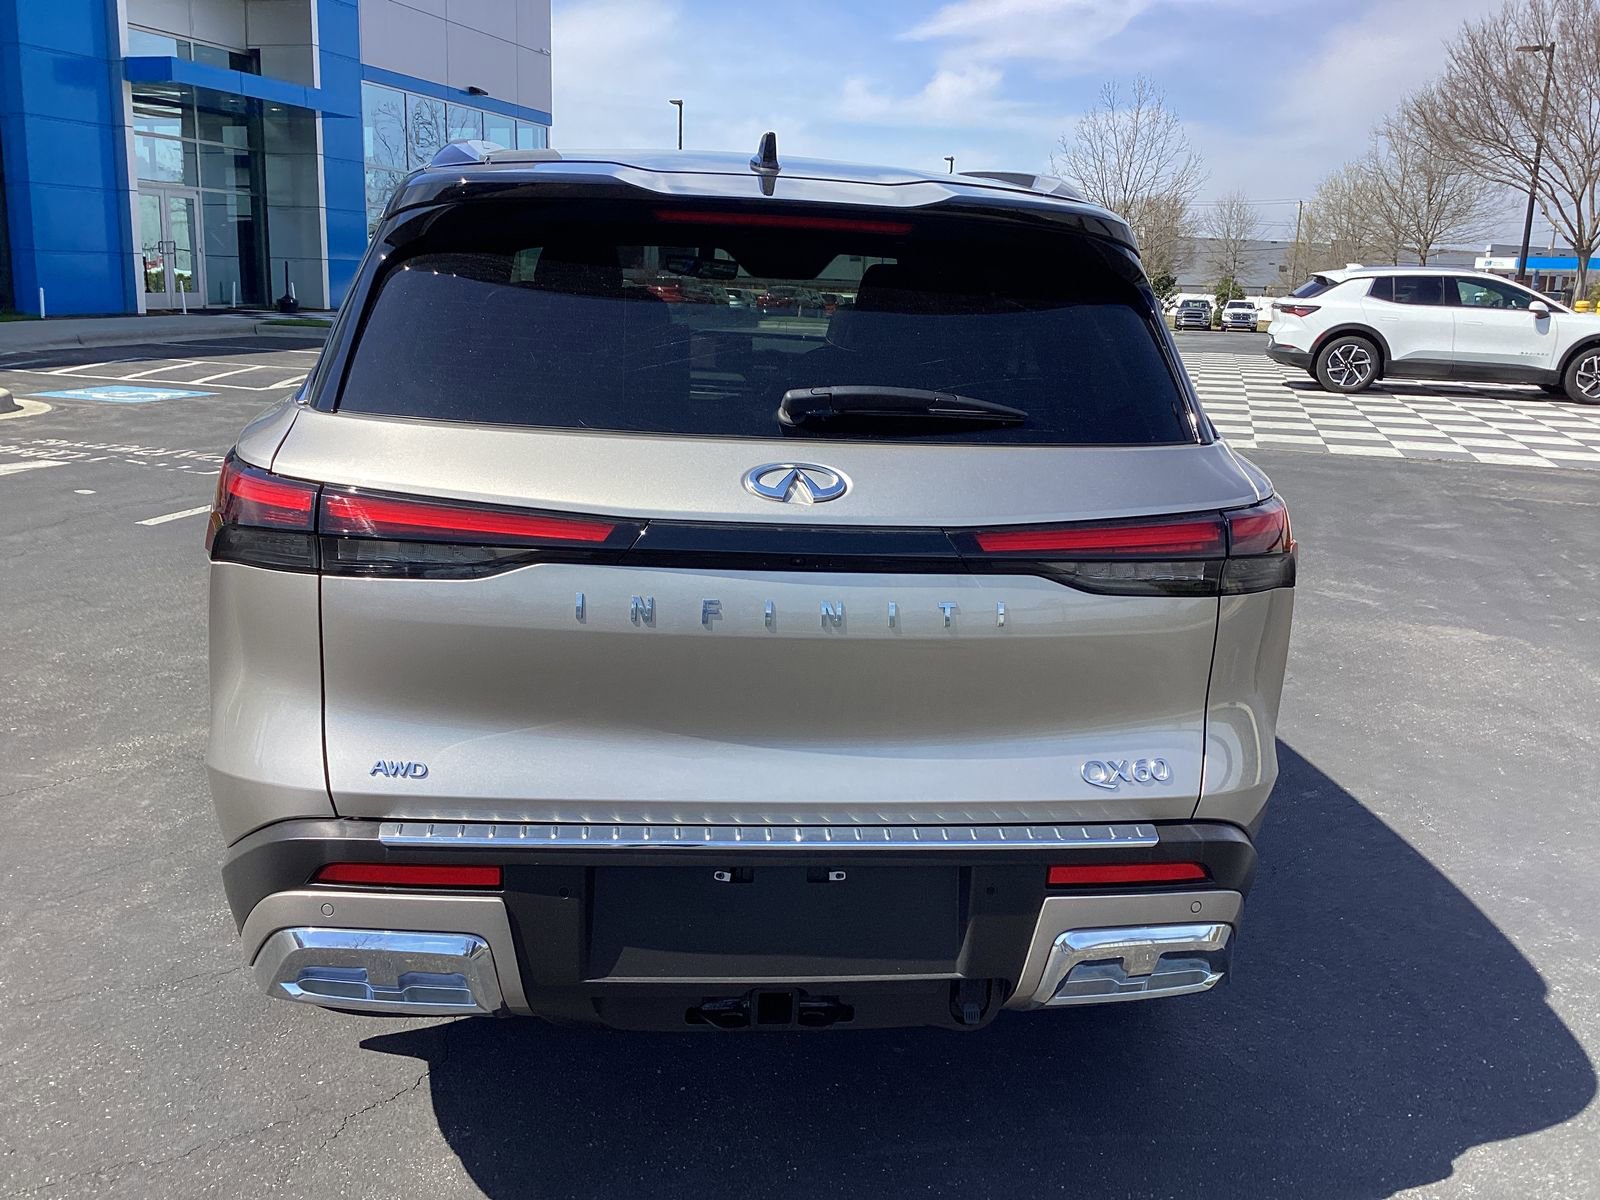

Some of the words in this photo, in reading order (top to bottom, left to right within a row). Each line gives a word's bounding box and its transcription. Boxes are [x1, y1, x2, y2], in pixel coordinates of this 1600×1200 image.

[575, 591, 1005, 627] INFINITI
[370, 760, 428, 779] AWD
[1081, 758, 1170, 789] QX60
